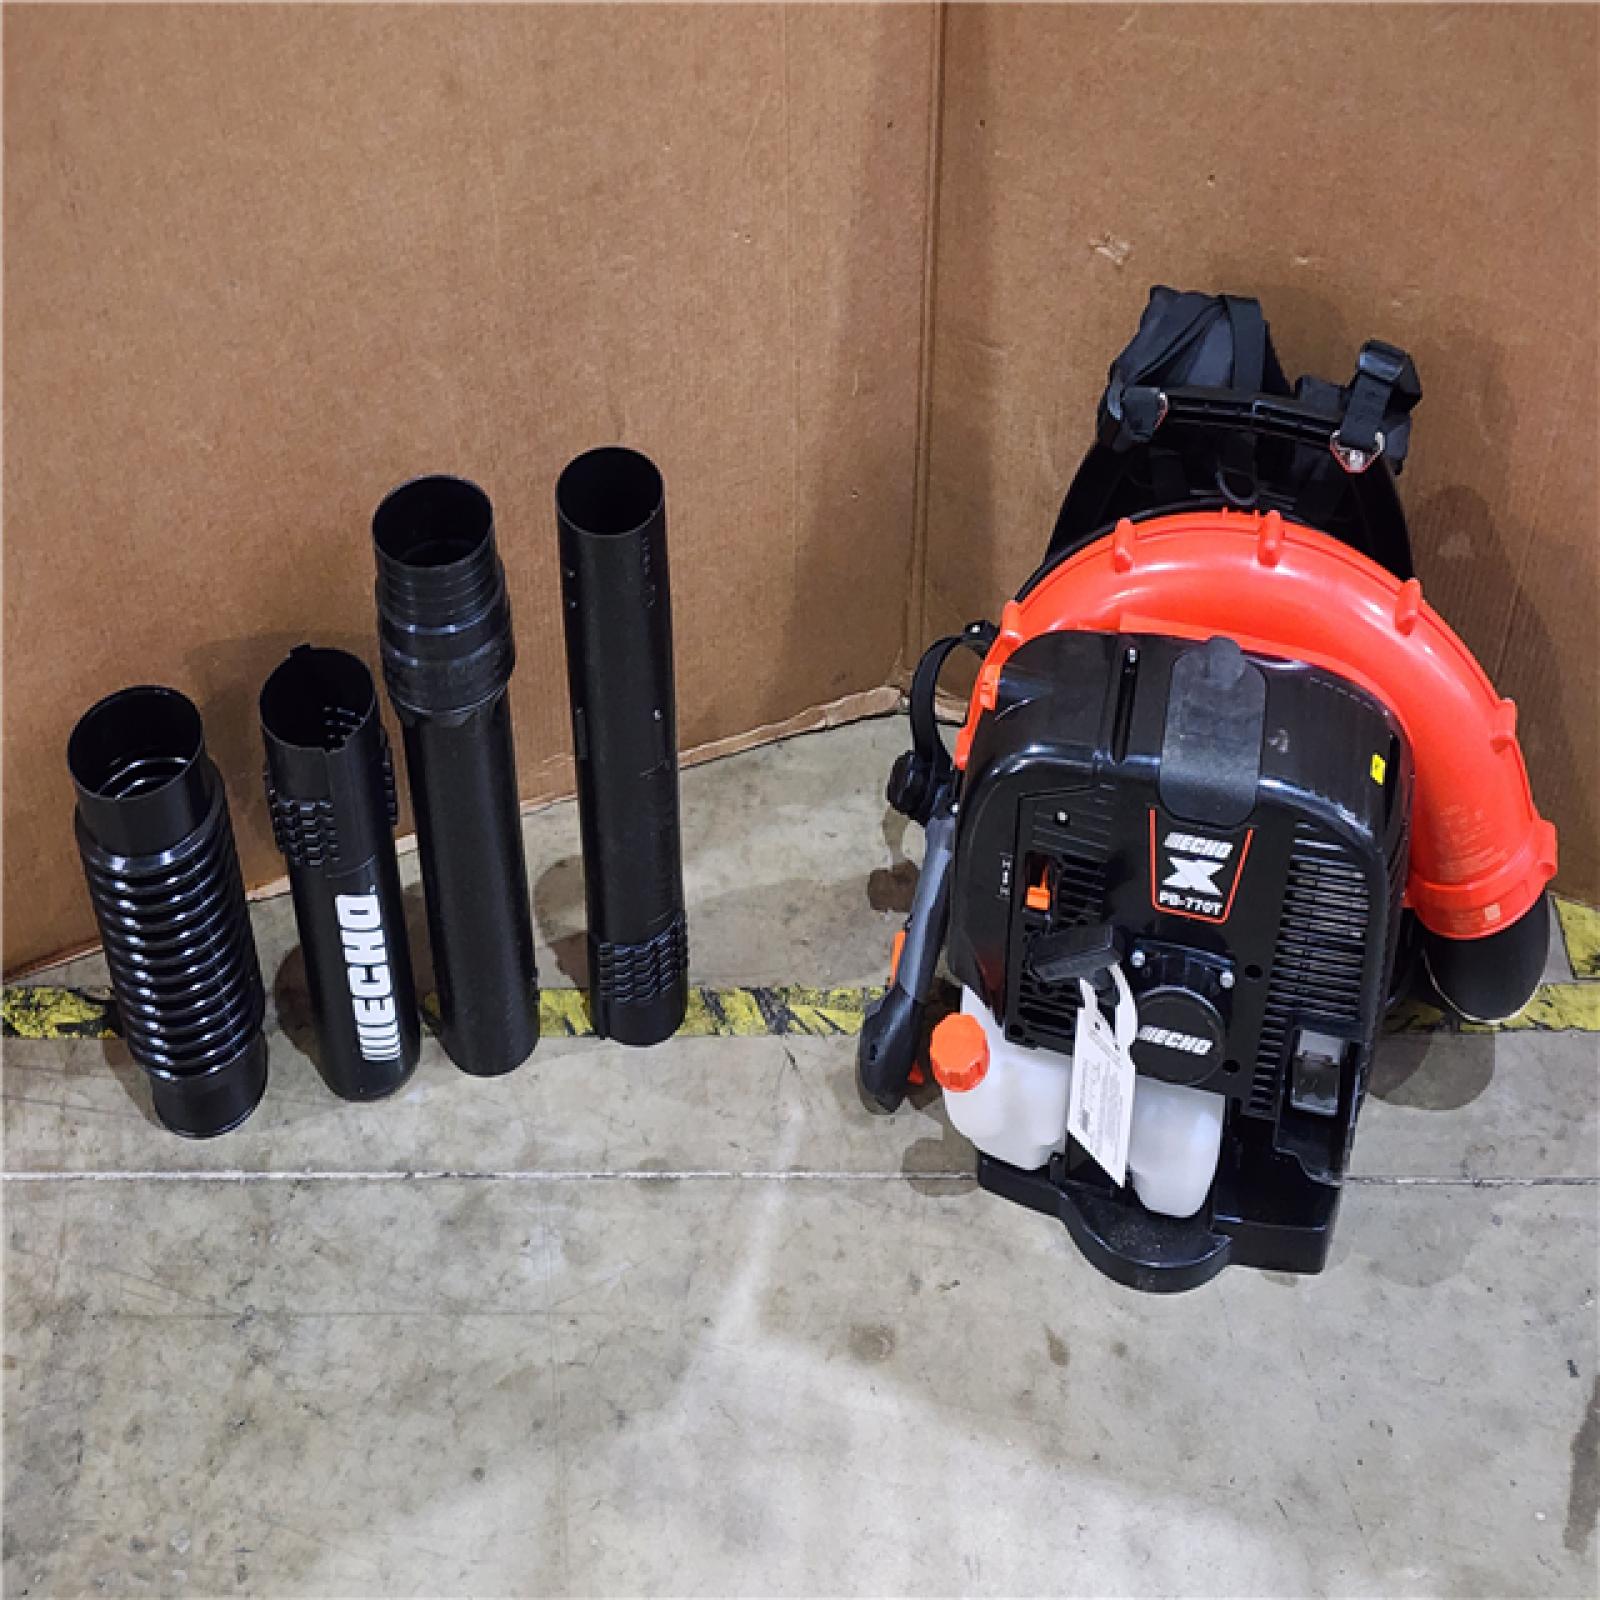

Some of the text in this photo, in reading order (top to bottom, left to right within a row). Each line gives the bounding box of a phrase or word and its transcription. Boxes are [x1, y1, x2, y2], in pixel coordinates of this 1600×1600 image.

[1171, 833, 1234, 859] ECHO
[335, 894, 397, 1026] ECHO
[1150, 1026, 1214, 1056] ECHO
